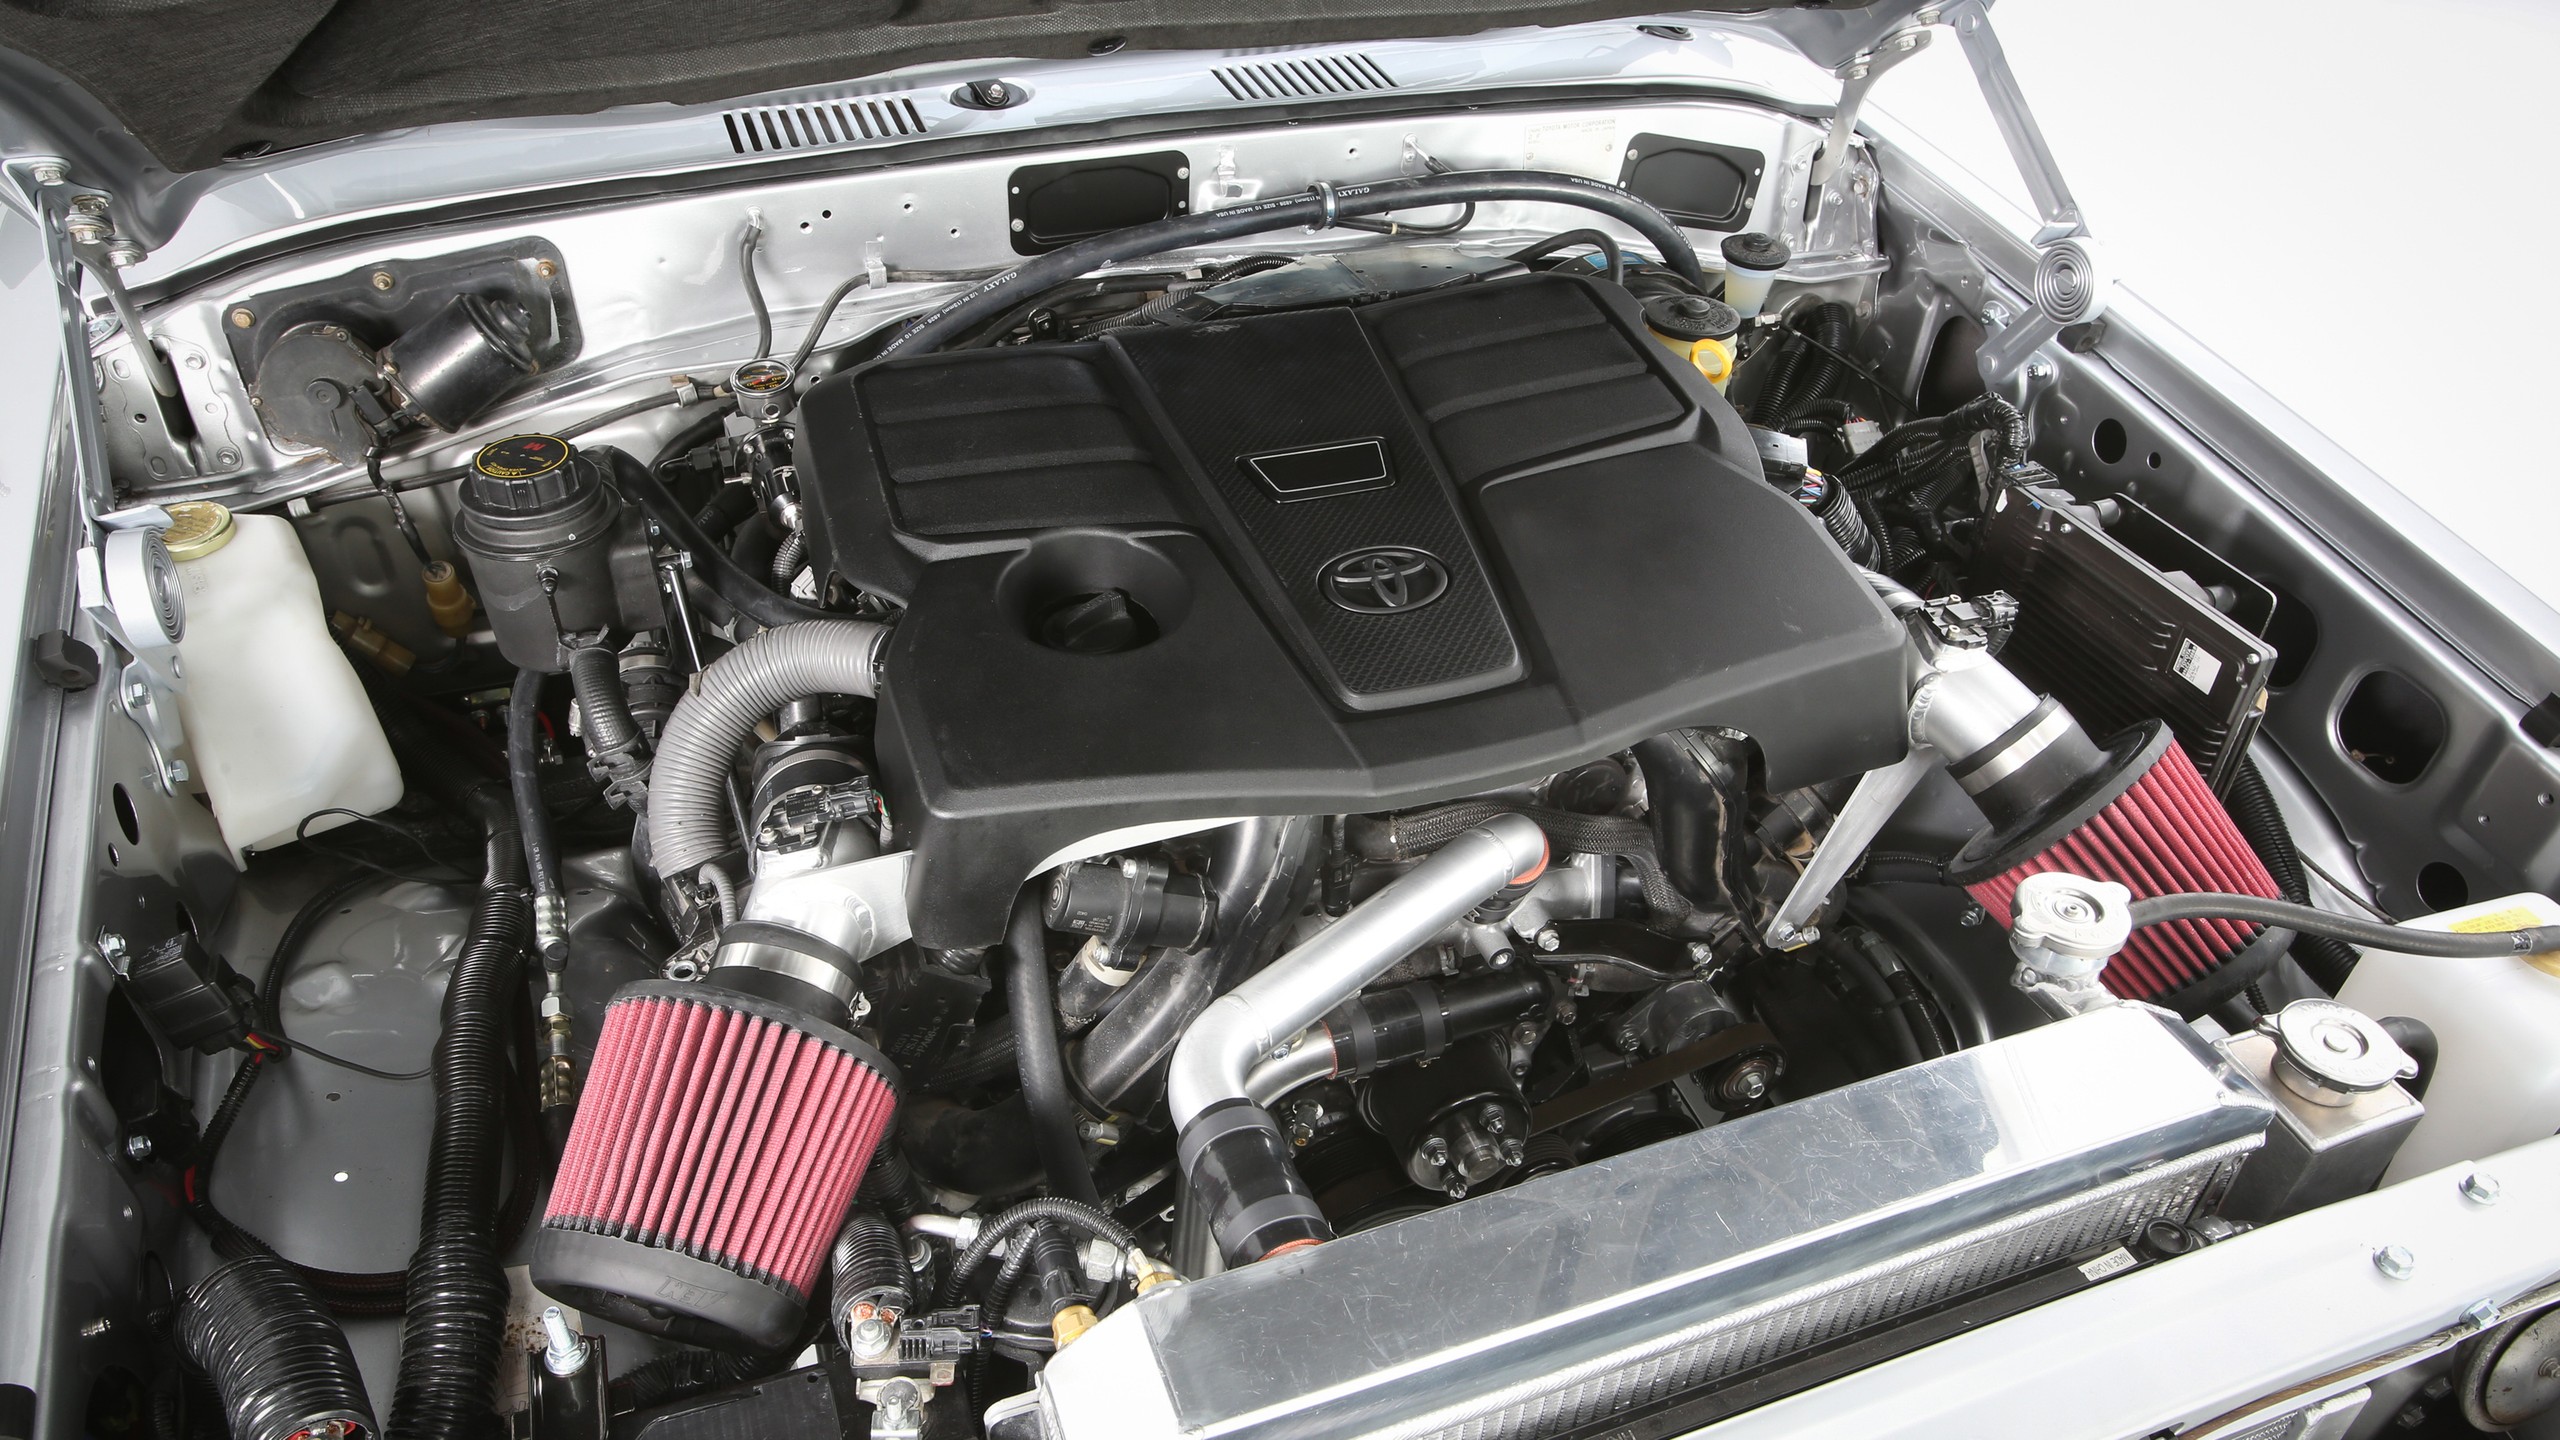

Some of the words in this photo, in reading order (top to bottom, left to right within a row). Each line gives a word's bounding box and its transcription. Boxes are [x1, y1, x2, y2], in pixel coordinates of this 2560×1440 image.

[983, 272, 1017, 292] GALAXY
[942, 302, 962, 314] (13mm)
[912, 324, 925, 334] SIZE
[887, 339, 904, 352] MADE
[2103, 1261, 2112, 1270] IN
[2110, 1252, 2131, 1267] MADE
[2085, 1263, 2107, 1278] CHINA
